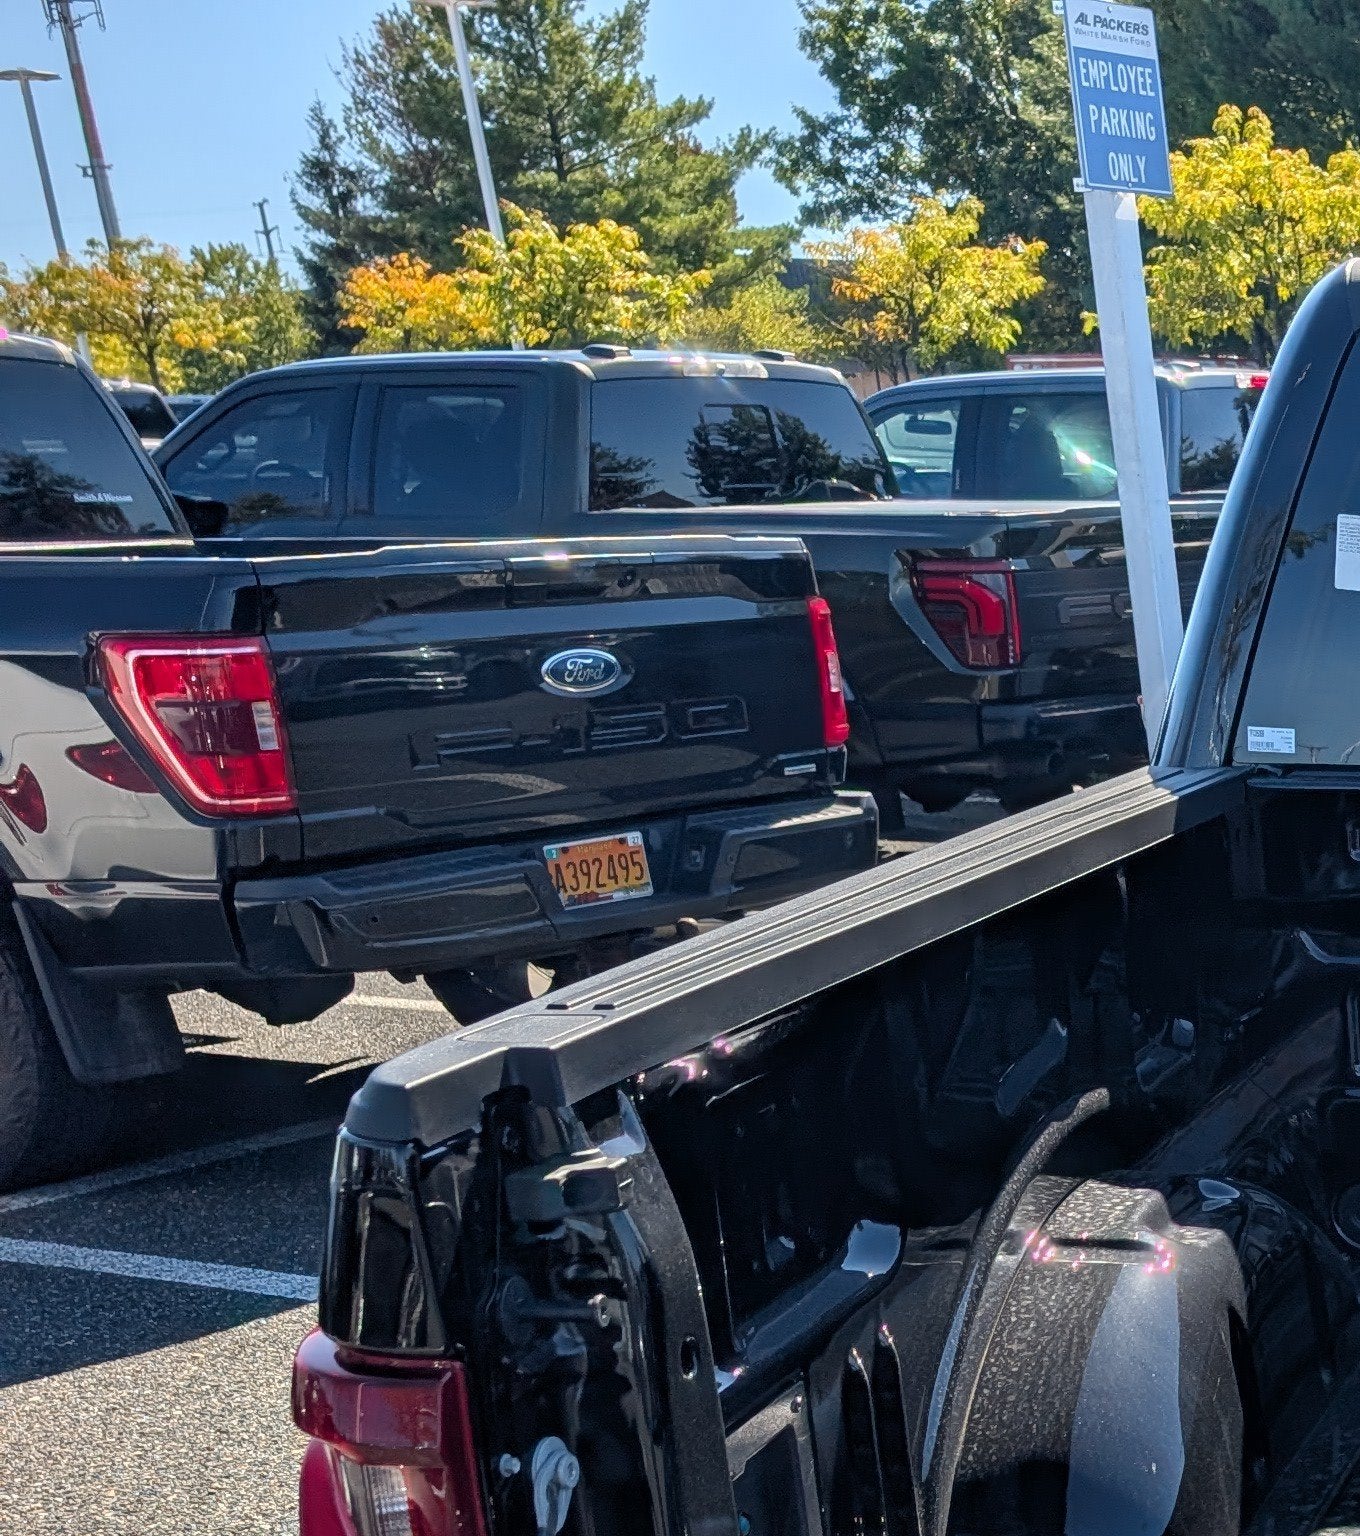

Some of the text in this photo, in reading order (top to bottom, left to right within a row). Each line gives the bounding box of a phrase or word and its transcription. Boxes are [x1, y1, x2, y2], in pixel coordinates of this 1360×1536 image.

[1074, 12, 1149, 36] AL PACKER'S
[1079, 57, 1155, 97] EMPLOYEE
[1089, 104, 1156, 141] PARKING
[1108, 151, 1146, 183] ONLY
[565, 658, 605, 682] Ford
[555, 849, 645, 893] A392495
